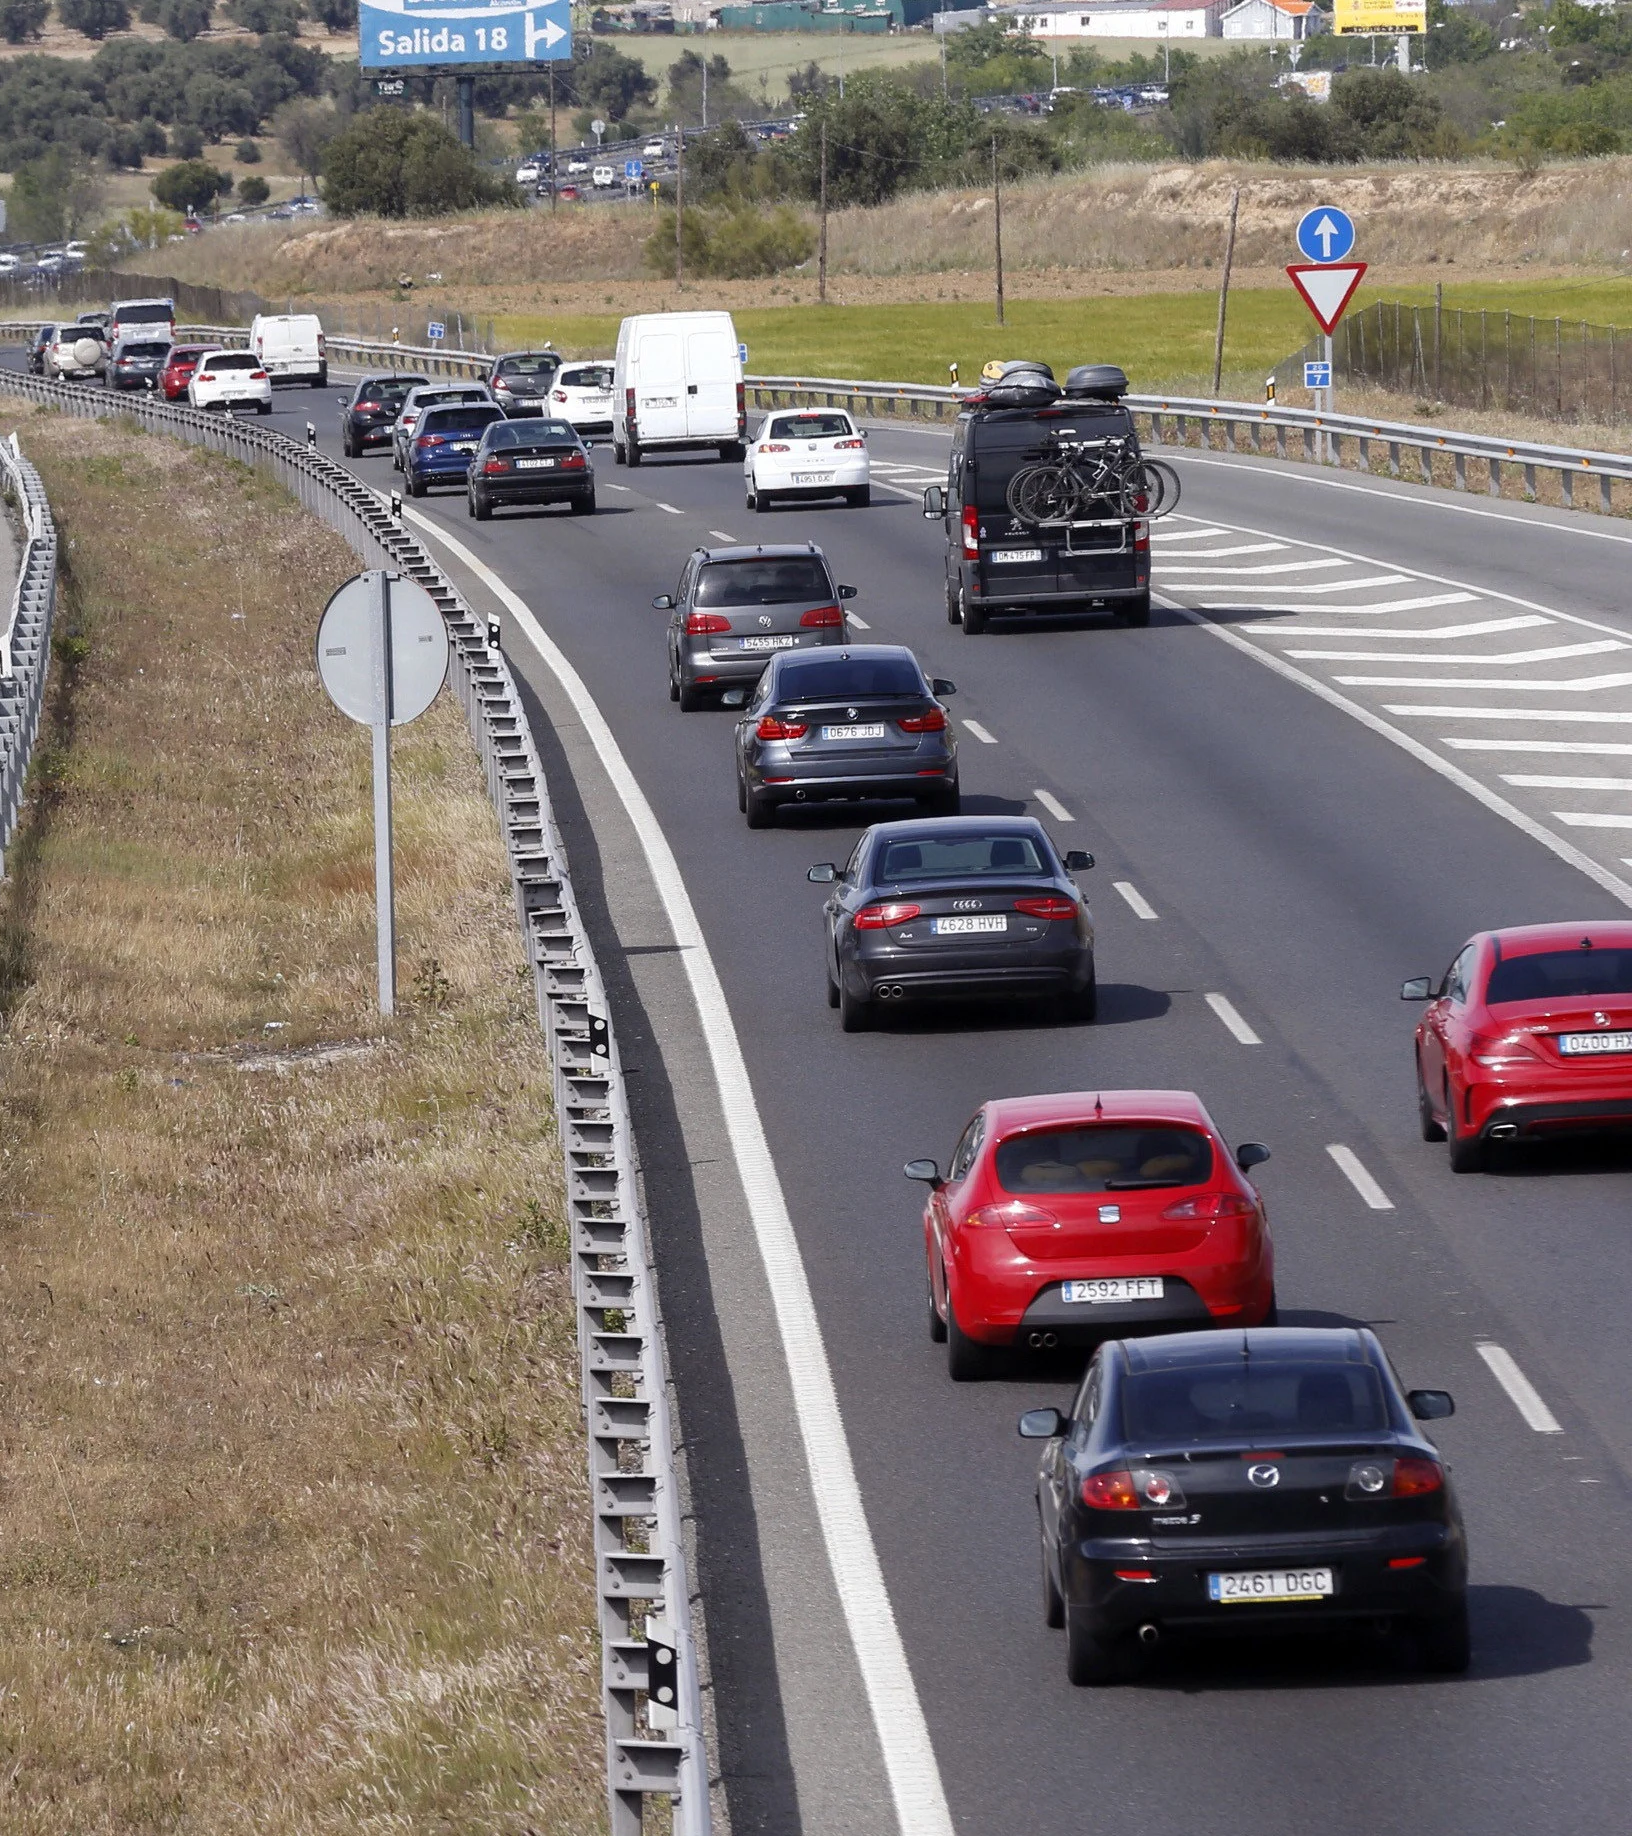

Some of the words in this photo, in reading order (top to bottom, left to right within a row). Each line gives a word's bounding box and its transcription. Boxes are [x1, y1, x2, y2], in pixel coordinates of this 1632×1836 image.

[378, 27, 465, 56] Salida
[475, 27, 508, 51] 18
[1313, 374, 1323, 385] 7
[746, 637, 769, 648] 5455
[829, 726, 857, 738] 0676
[939, 916, 975, 932] 4628
[978, 915, 1004, 930] HVH
[1570, 1034, 1610, 1051] 0400
[1077, 1280, 1118, 1299] 2592
[1126, 1278, 1157, 1297] FFT
[1224, 1573, 1276, 1596] 2461
[1286, 1570, 1327, 1592] DGC
